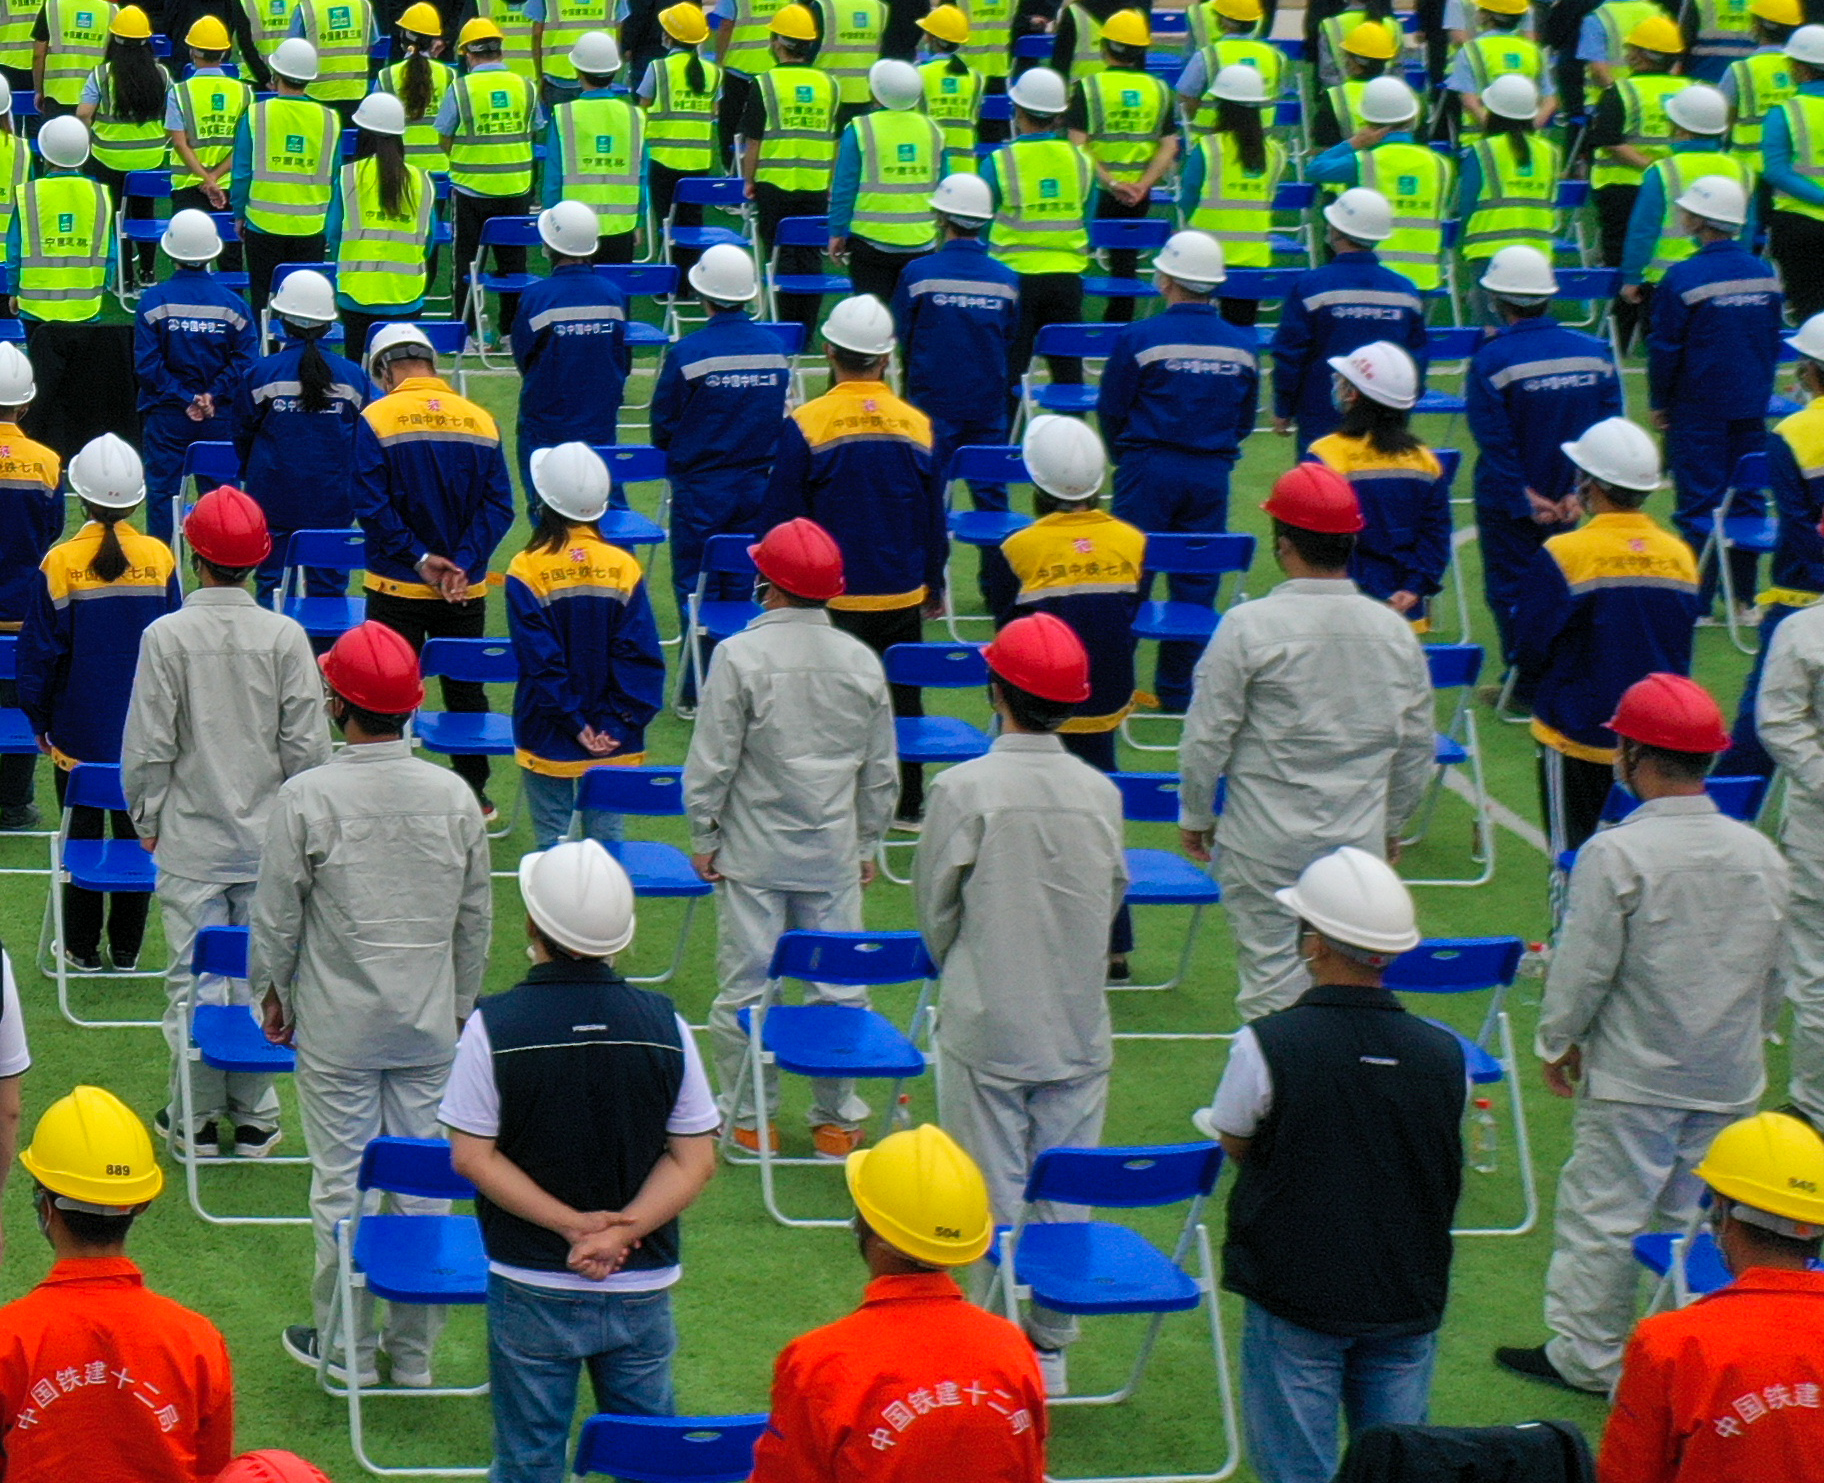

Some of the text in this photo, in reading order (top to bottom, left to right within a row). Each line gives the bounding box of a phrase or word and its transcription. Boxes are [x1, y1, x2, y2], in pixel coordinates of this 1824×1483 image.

[397, 413, 475, 427] 中国中铁七局
[70, 565, 157, 583] 中国七局
[538, 565, 623, 582] 中国中铁七局
[105, 1164, 131, 1177] 889
[16, 1360, 180, 1434] 中国铁建十二局
[867, 1380, 1032, 1451] 中国铁建十二局
